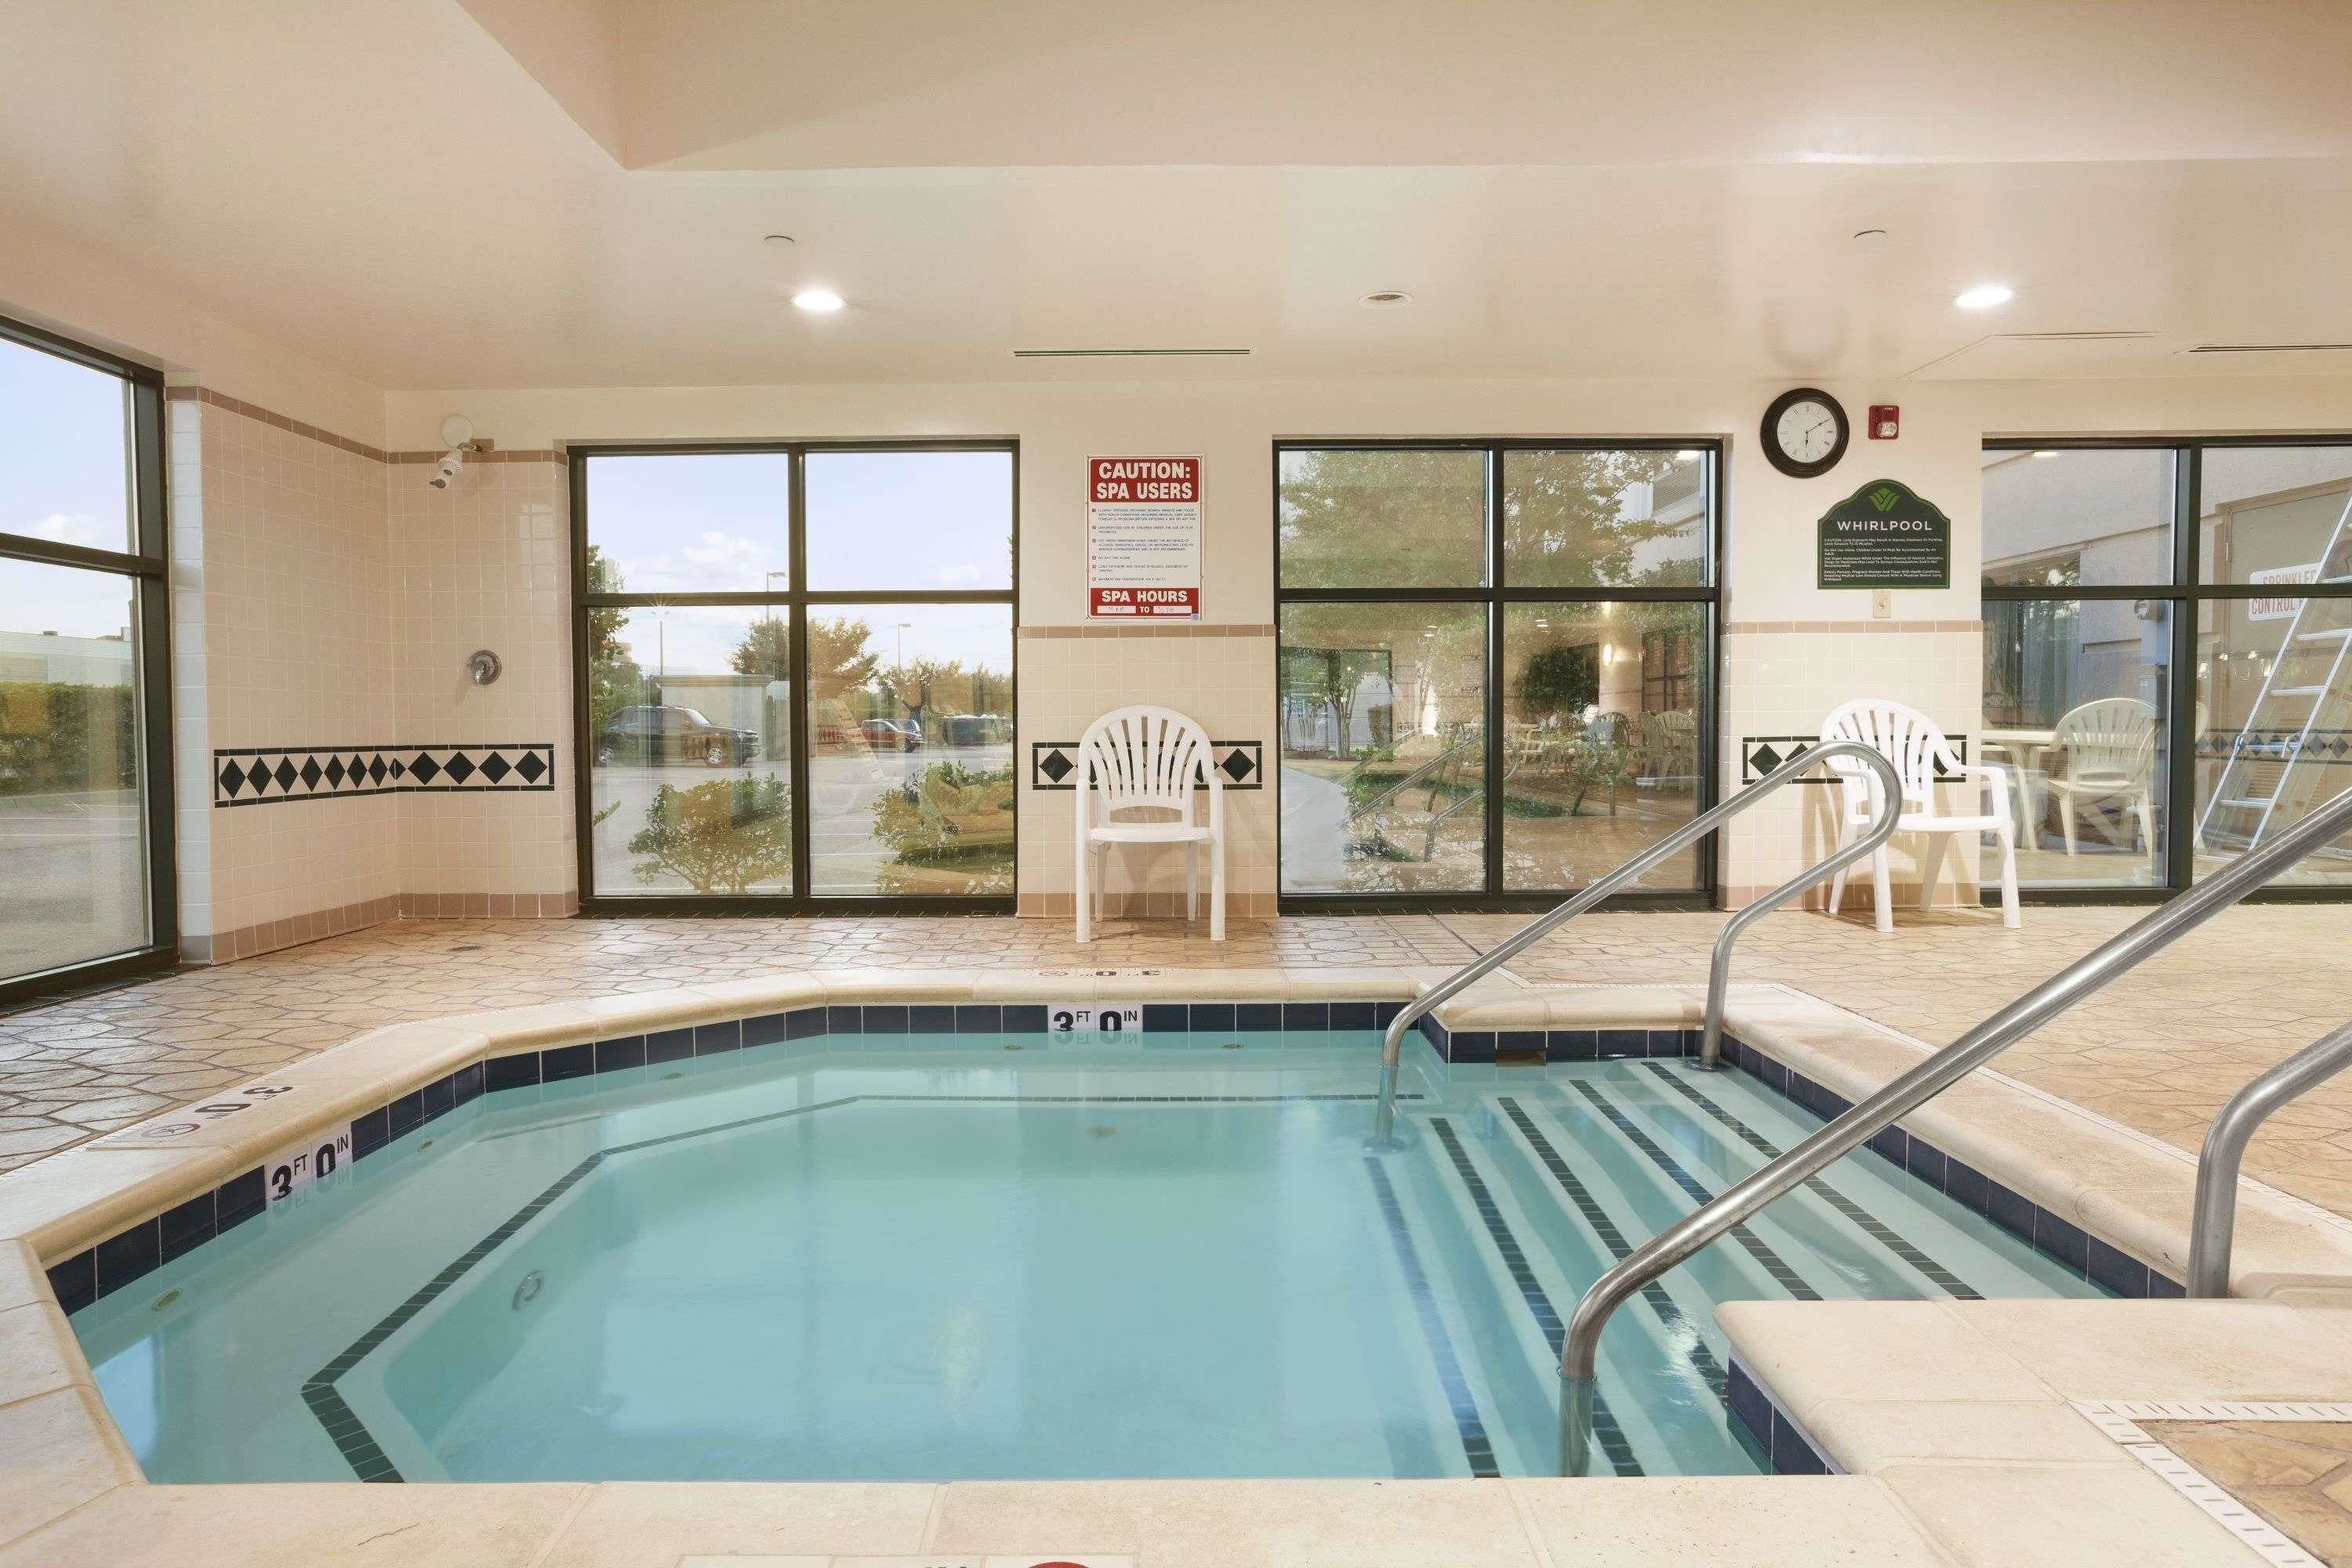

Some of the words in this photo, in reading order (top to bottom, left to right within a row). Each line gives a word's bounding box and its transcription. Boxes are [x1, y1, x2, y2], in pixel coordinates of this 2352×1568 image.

[1098, 462, 1191, 479] CAUTION:
[1097, 482, 1130, 499] SPA
[1137, 482, 1192, 499] USERS
[1837, 521, 1933, 531] WHIRLPOOL
[1101, 590, 1131, 603] SPA
[1137, 590, 1188, 603] HOURS
[1054, 1011, 1074, 1032] 3
[1076, 1011, 1091, 1022] FT
[1100, 1011, 1122, 1032] 0
[1123, 1010, 1138, 1022] IN
[271, 1164, 293, 1201] 3
[293, 1153, 308, 1176] FT
[315, 1143, 336, 1179] 0
[336, 1133, 350, 1154] IN
